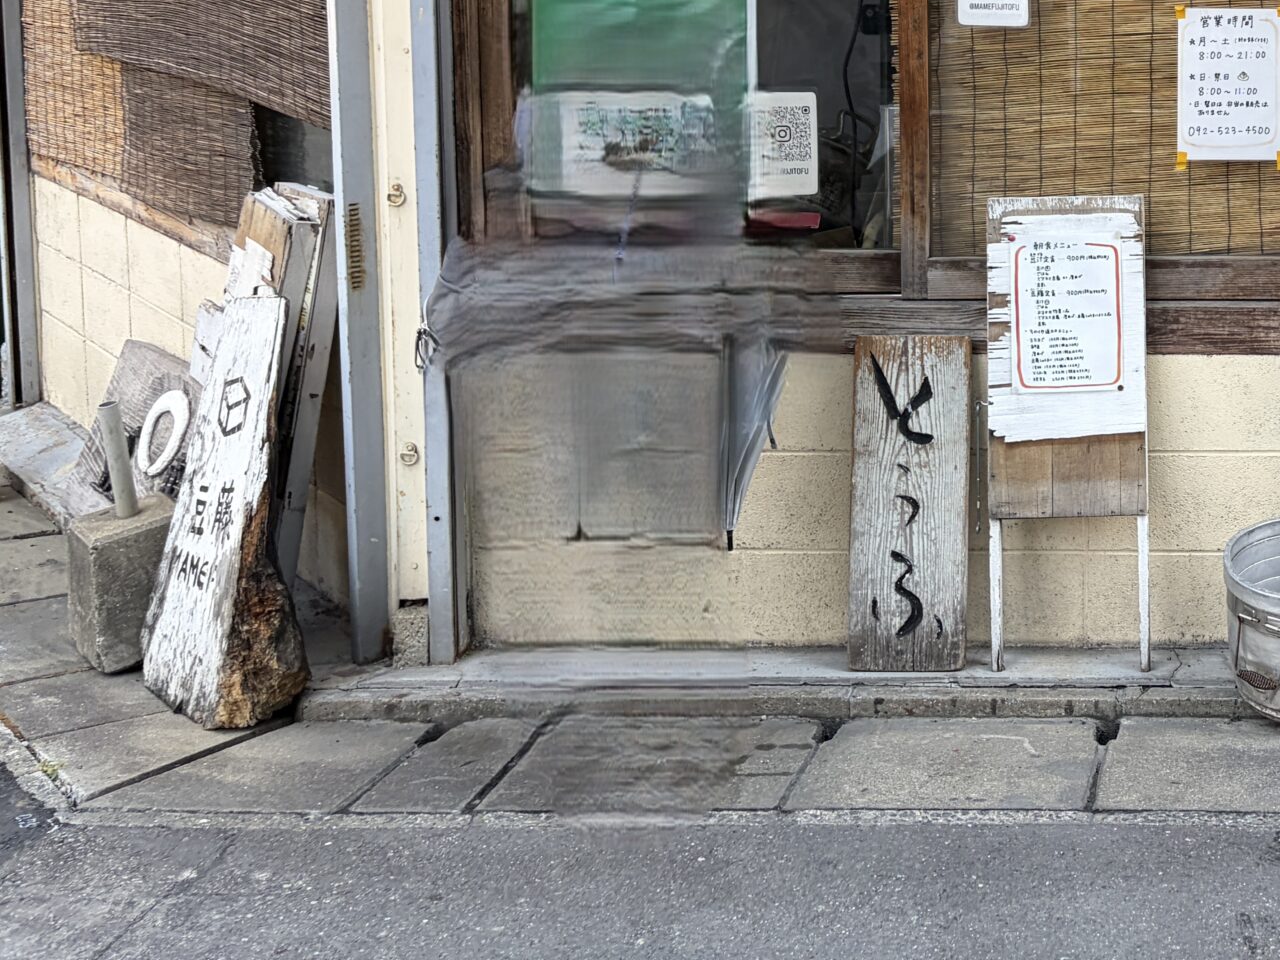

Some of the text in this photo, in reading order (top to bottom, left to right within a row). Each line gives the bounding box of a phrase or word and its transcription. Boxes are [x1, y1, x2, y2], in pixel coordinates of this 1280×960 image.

[1200, 14, 1254, 29] 営業時間
[1188, 125, 1271, 137] 092-523-4500
